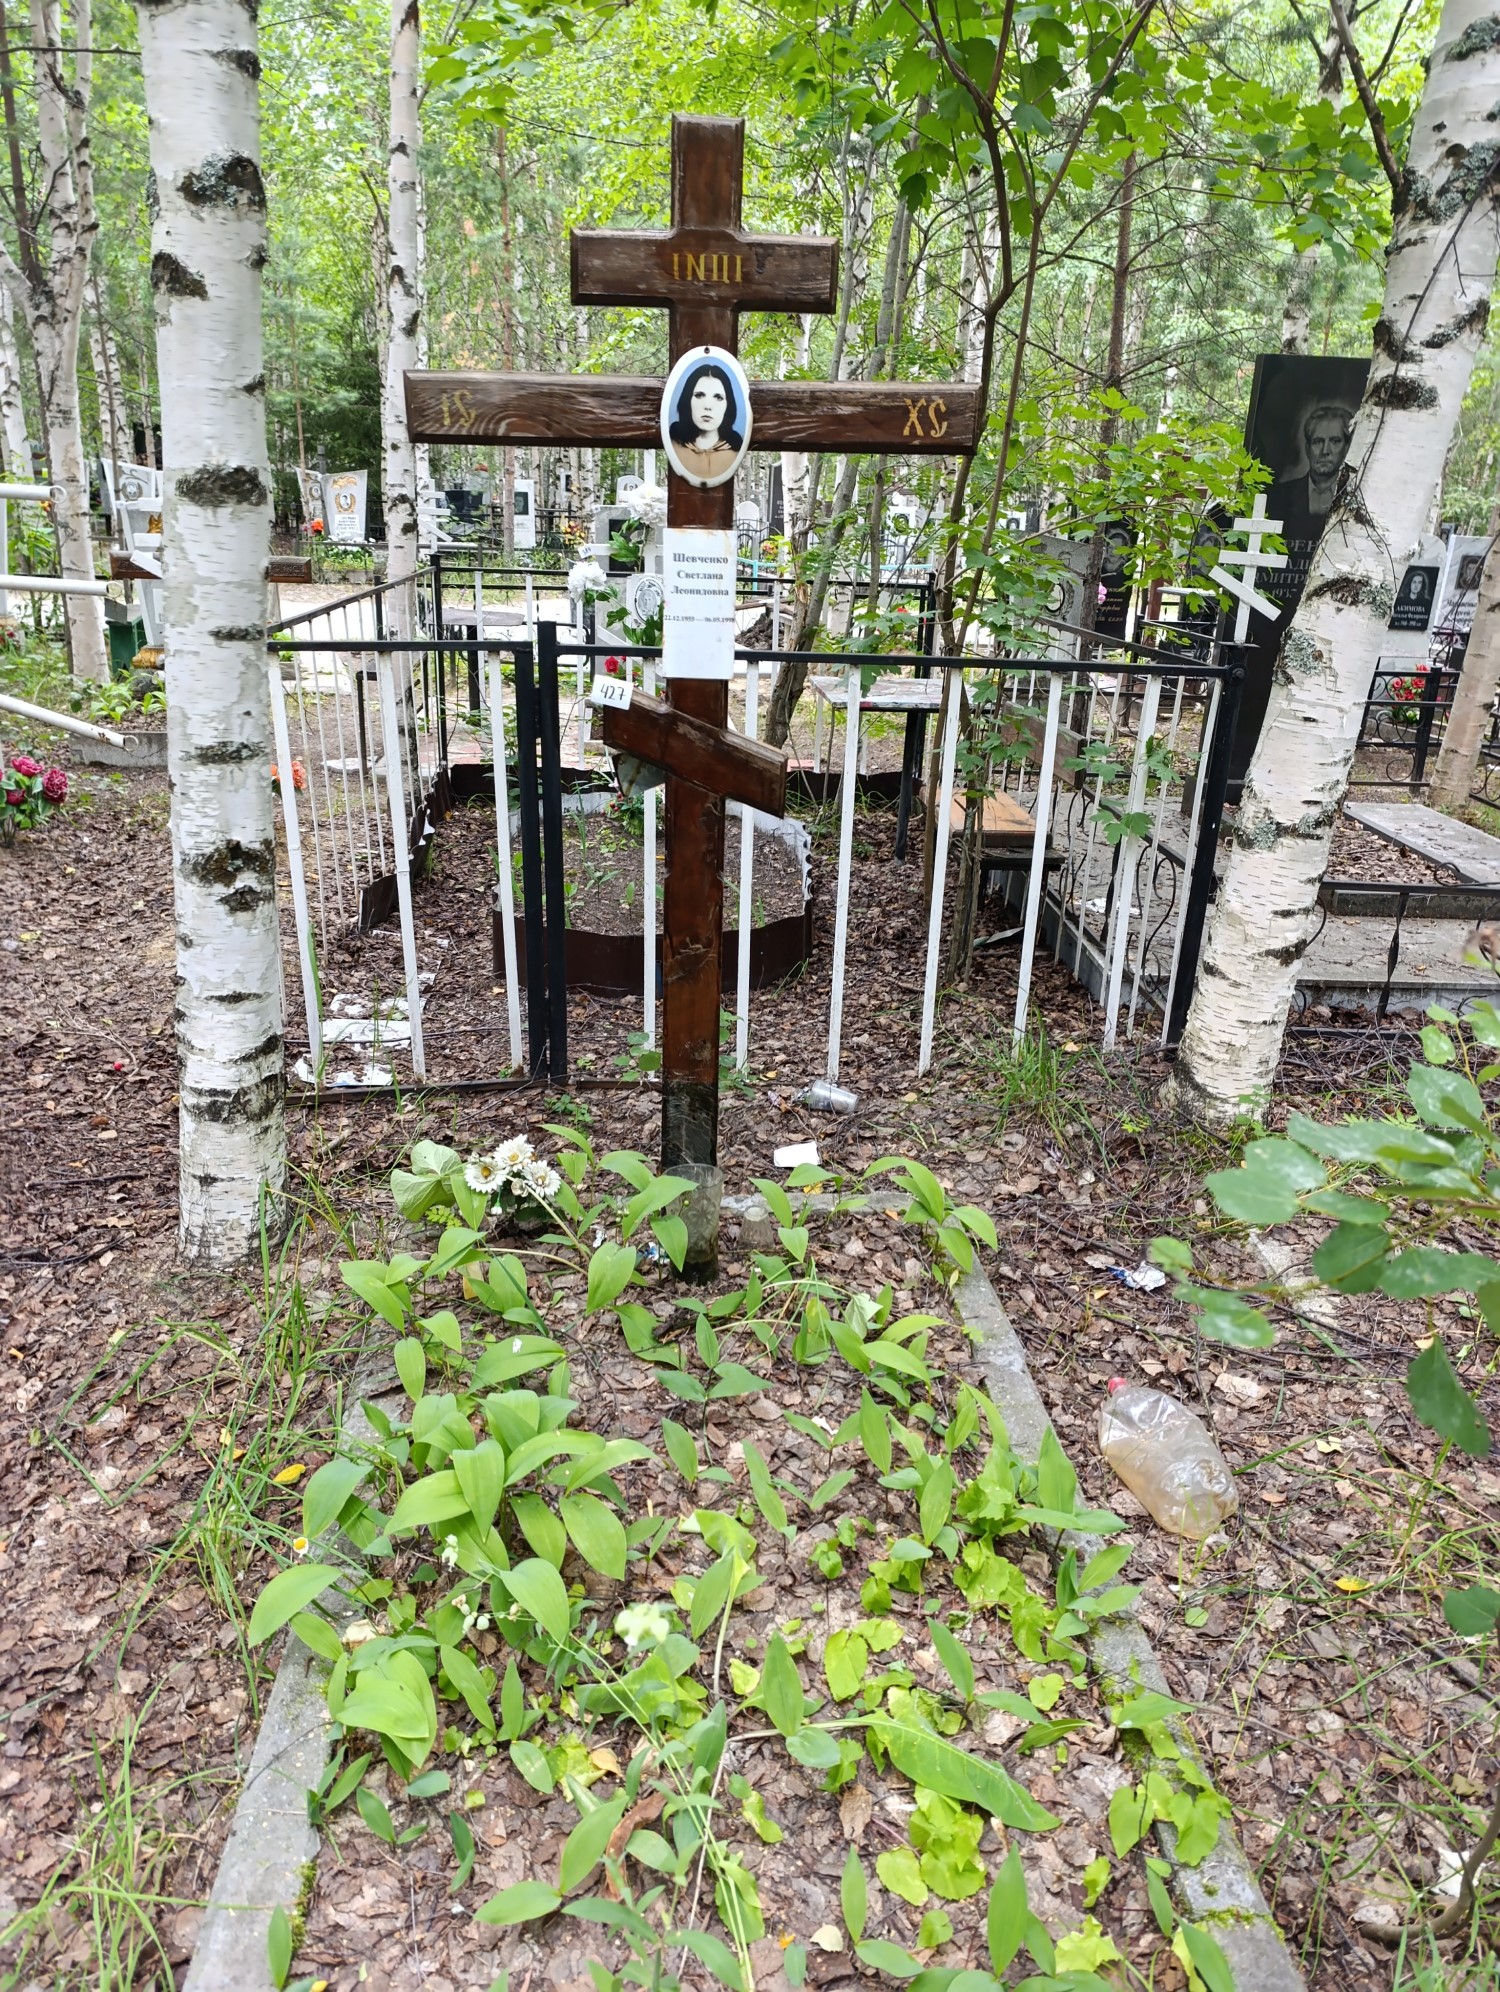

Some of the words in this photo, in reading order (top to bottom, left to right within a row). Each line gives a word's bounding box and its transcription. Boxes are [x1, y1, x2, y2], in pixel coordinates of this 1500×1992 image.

[673, 552, 729, 564] Шевченко
[677, 569, 724, 580] Светлана
[670, 585, 729, 596] Леонидовна
[600, 683, 626, 701] 427
